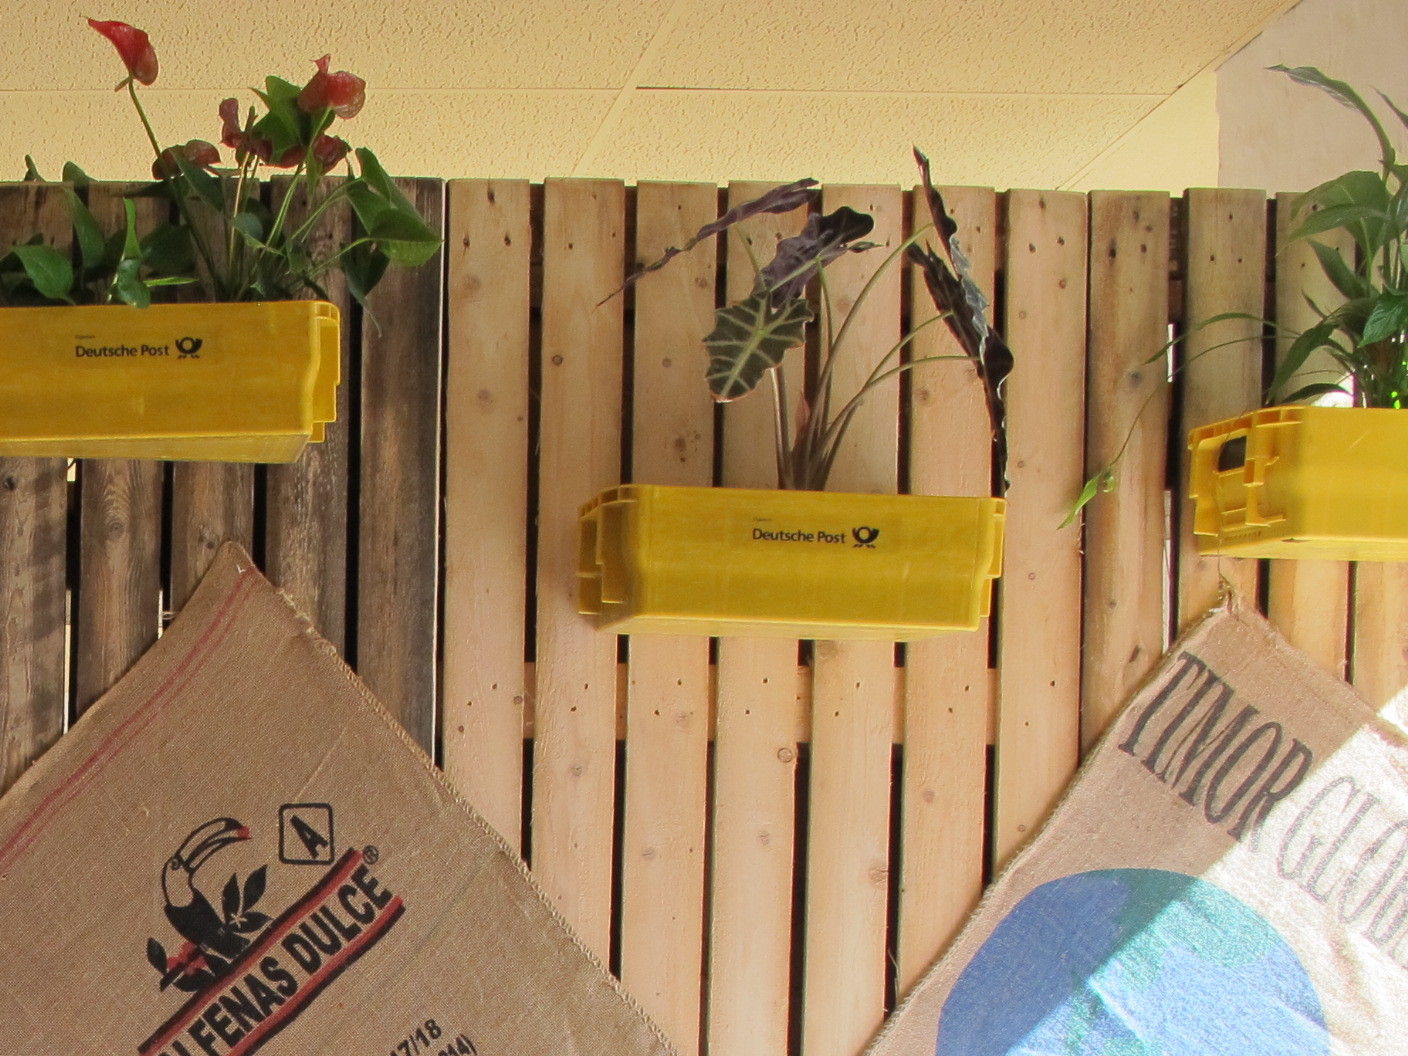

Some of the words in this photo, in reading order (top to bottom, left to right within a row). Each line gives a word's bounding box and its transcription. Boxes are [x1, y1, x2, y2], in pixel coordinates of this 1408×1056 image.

[75, 345, 138, 358] Deutsche
[140, 344, 170, 357] Post
[752, 528, 814, 542] Deutsche
[817, 531, 846, 544] Post
[1118, 651, 1313, 850] TIMOR
[290, 816, 329, 859] A
[281, 864, 393, 975] DULCE
